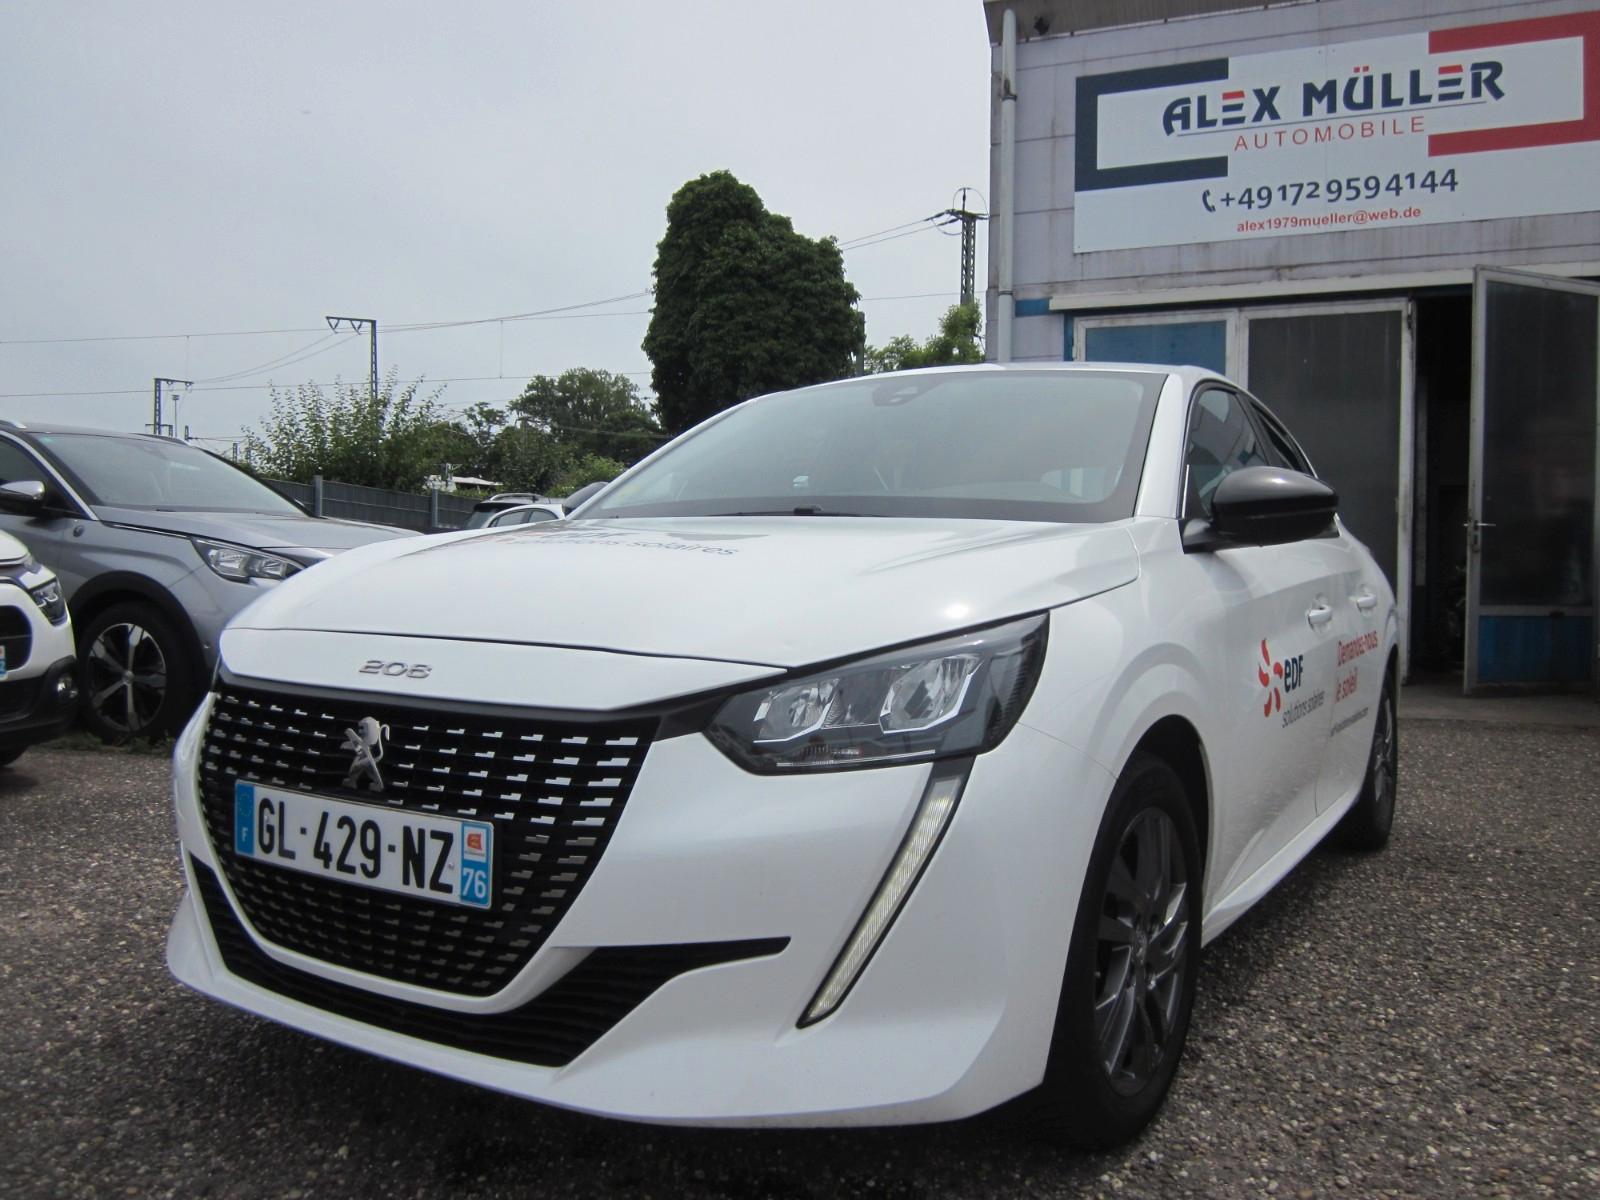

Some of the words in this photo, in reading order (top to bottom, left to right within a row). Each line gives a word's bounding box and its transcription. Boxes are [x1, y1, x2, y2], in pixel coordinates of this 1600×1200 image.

[1163, 86, 1281, 136] ALEX
[1302, 61, 1506, 117] MÜLLER
[1234, 116, 1425, 151] AUTOMOBILE
[1237, 207, 1422, 232] alex1979mueller@web.de
[359, 660, 432, 679] 208
[463, 867, 487, 899] 76
